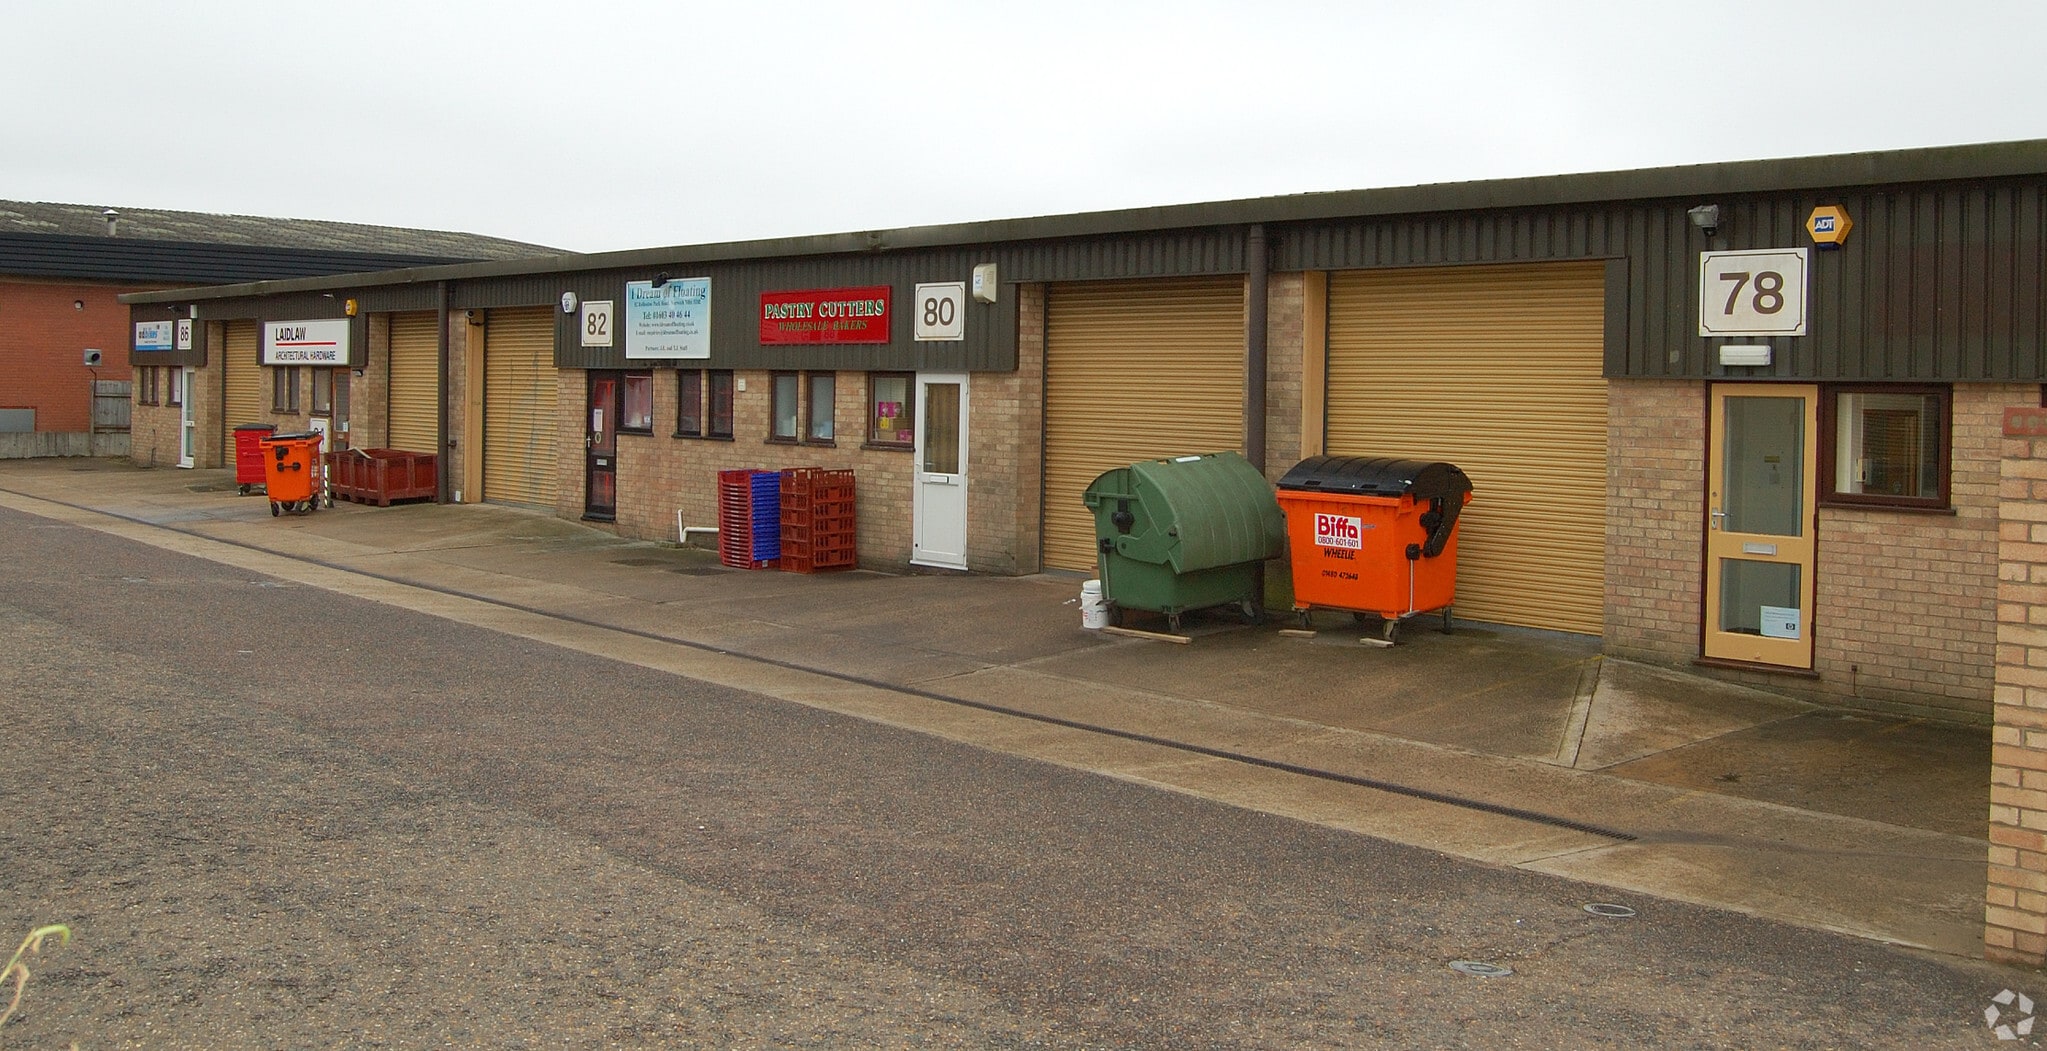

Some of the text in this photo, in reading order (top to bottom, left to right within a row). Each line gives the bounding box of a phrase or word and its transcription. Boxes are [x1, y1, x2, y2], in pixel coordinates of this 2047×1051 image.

[1814, 218, 1835, 230] ADT
[637, 286, 661, 299] Dream
[663, 285, 672, 299] of
[673, 284, 706, 300] Floating
[1719, 270, 1785, 316] 78
[643, 311, 652, 320] Tel:
[684, 310, 691, 318] 44
[764, 299, 885, 319] PASTRY CUTTERS
[923, 297, 955, 327] 80
[587, 312, 607, 336] 82
[778, 319, 868, 332] WHOLESALE BAKERS
[180, 325, 189, 342] 86
[275, 327, 307, 341] LAIDLAW
[275, 350, 336, 361] ARCHITECTURAL HARDWARE
[1317, 514, 1358, 539] Biffa
